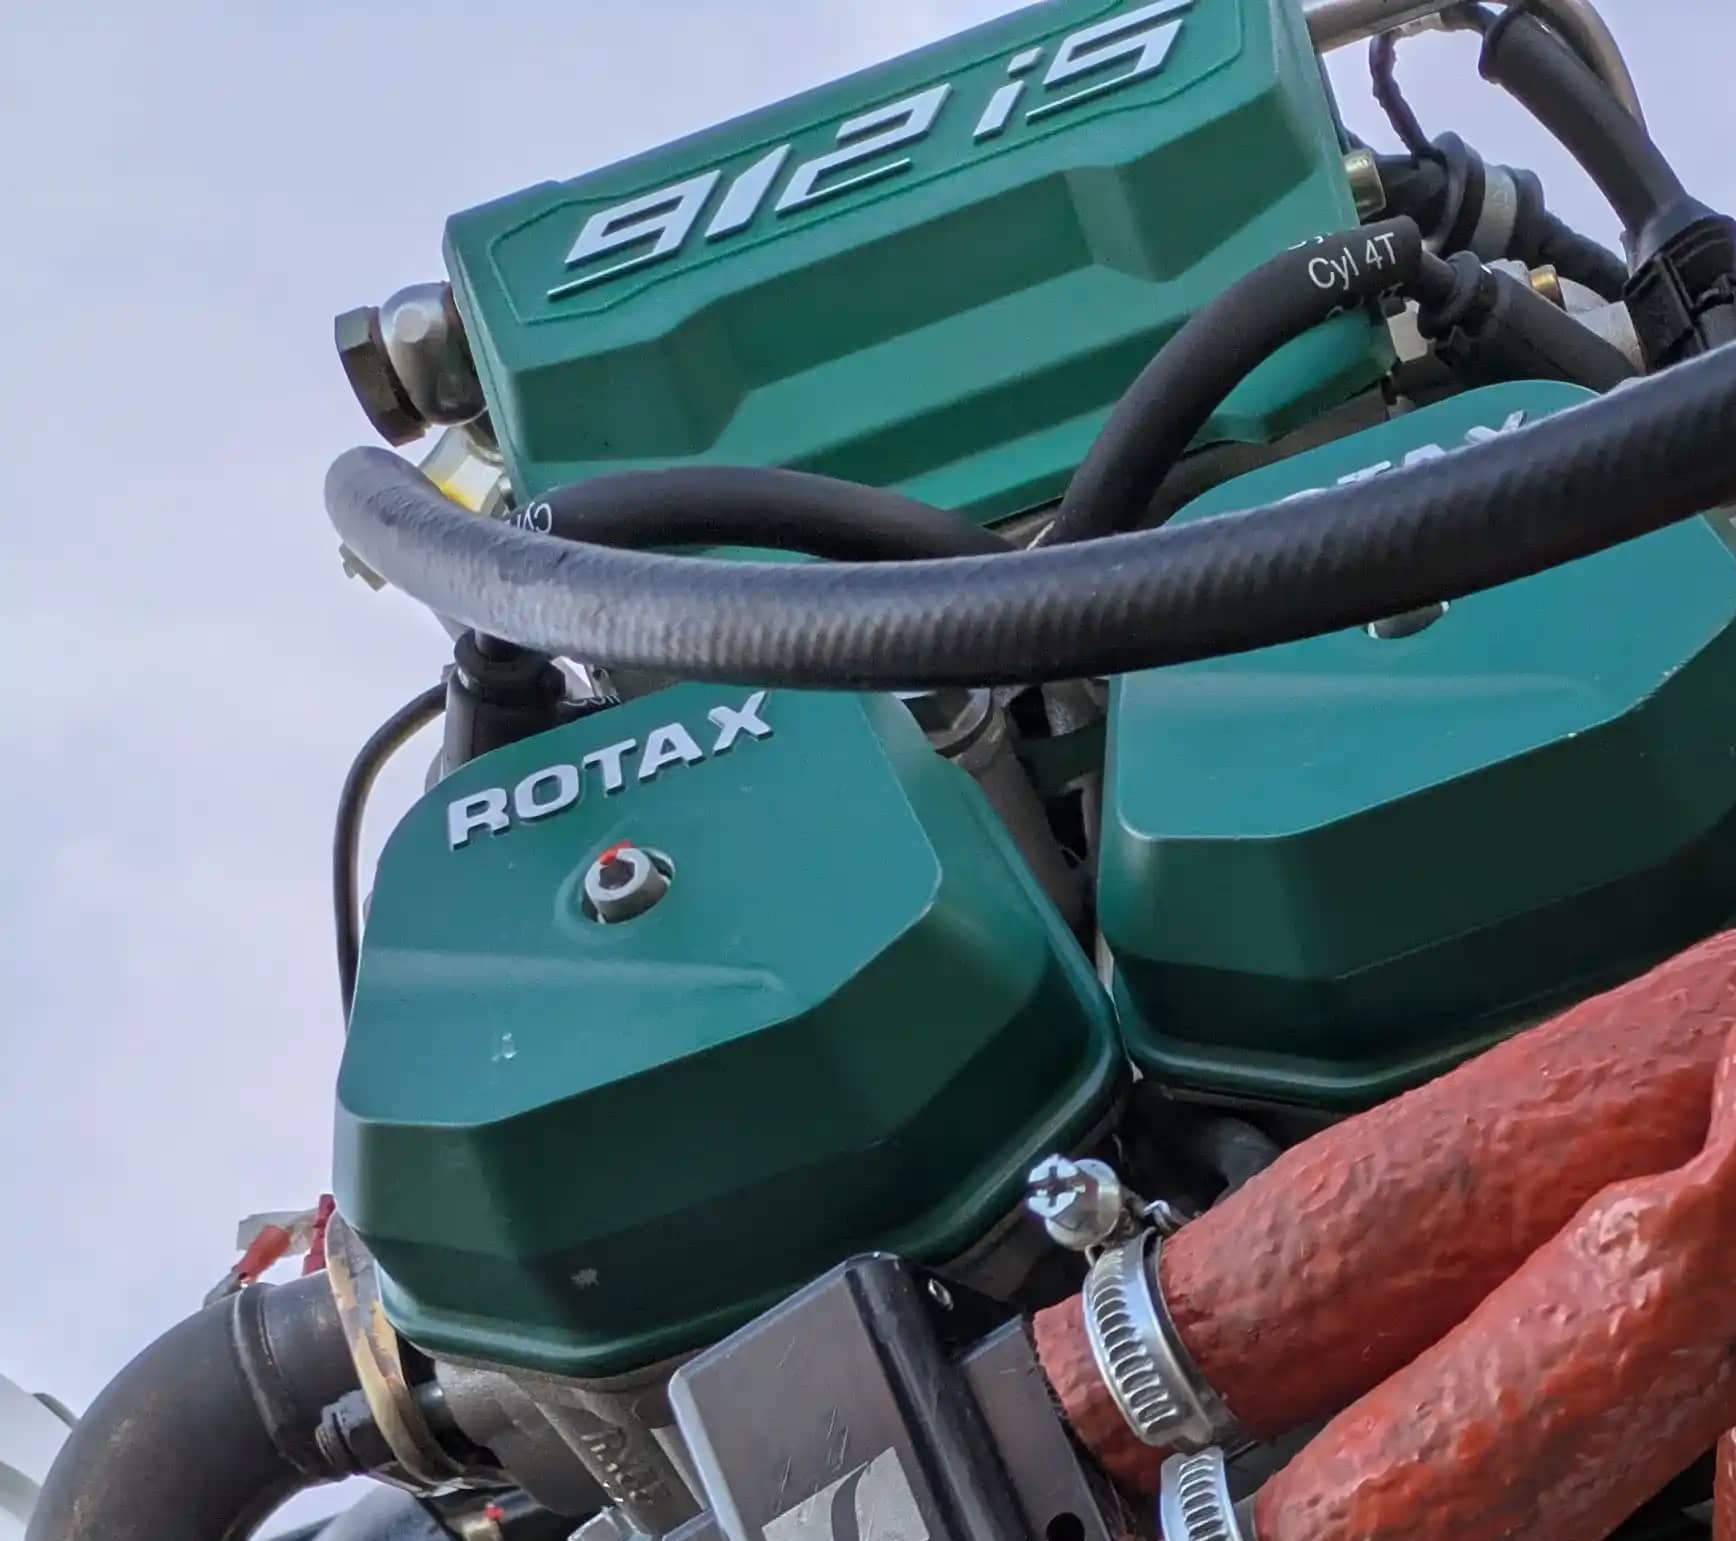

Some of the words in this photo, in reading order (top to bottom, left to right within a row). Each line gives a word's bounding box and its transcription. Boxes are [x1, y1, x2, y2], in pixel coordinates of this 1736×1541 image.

[547, 83, 953, 300] 912
[1308, 247, 1360, 291] Cyl
[1365, 232, 1397, 270] 4T
[446, 690, 775, 850] ROTAX
